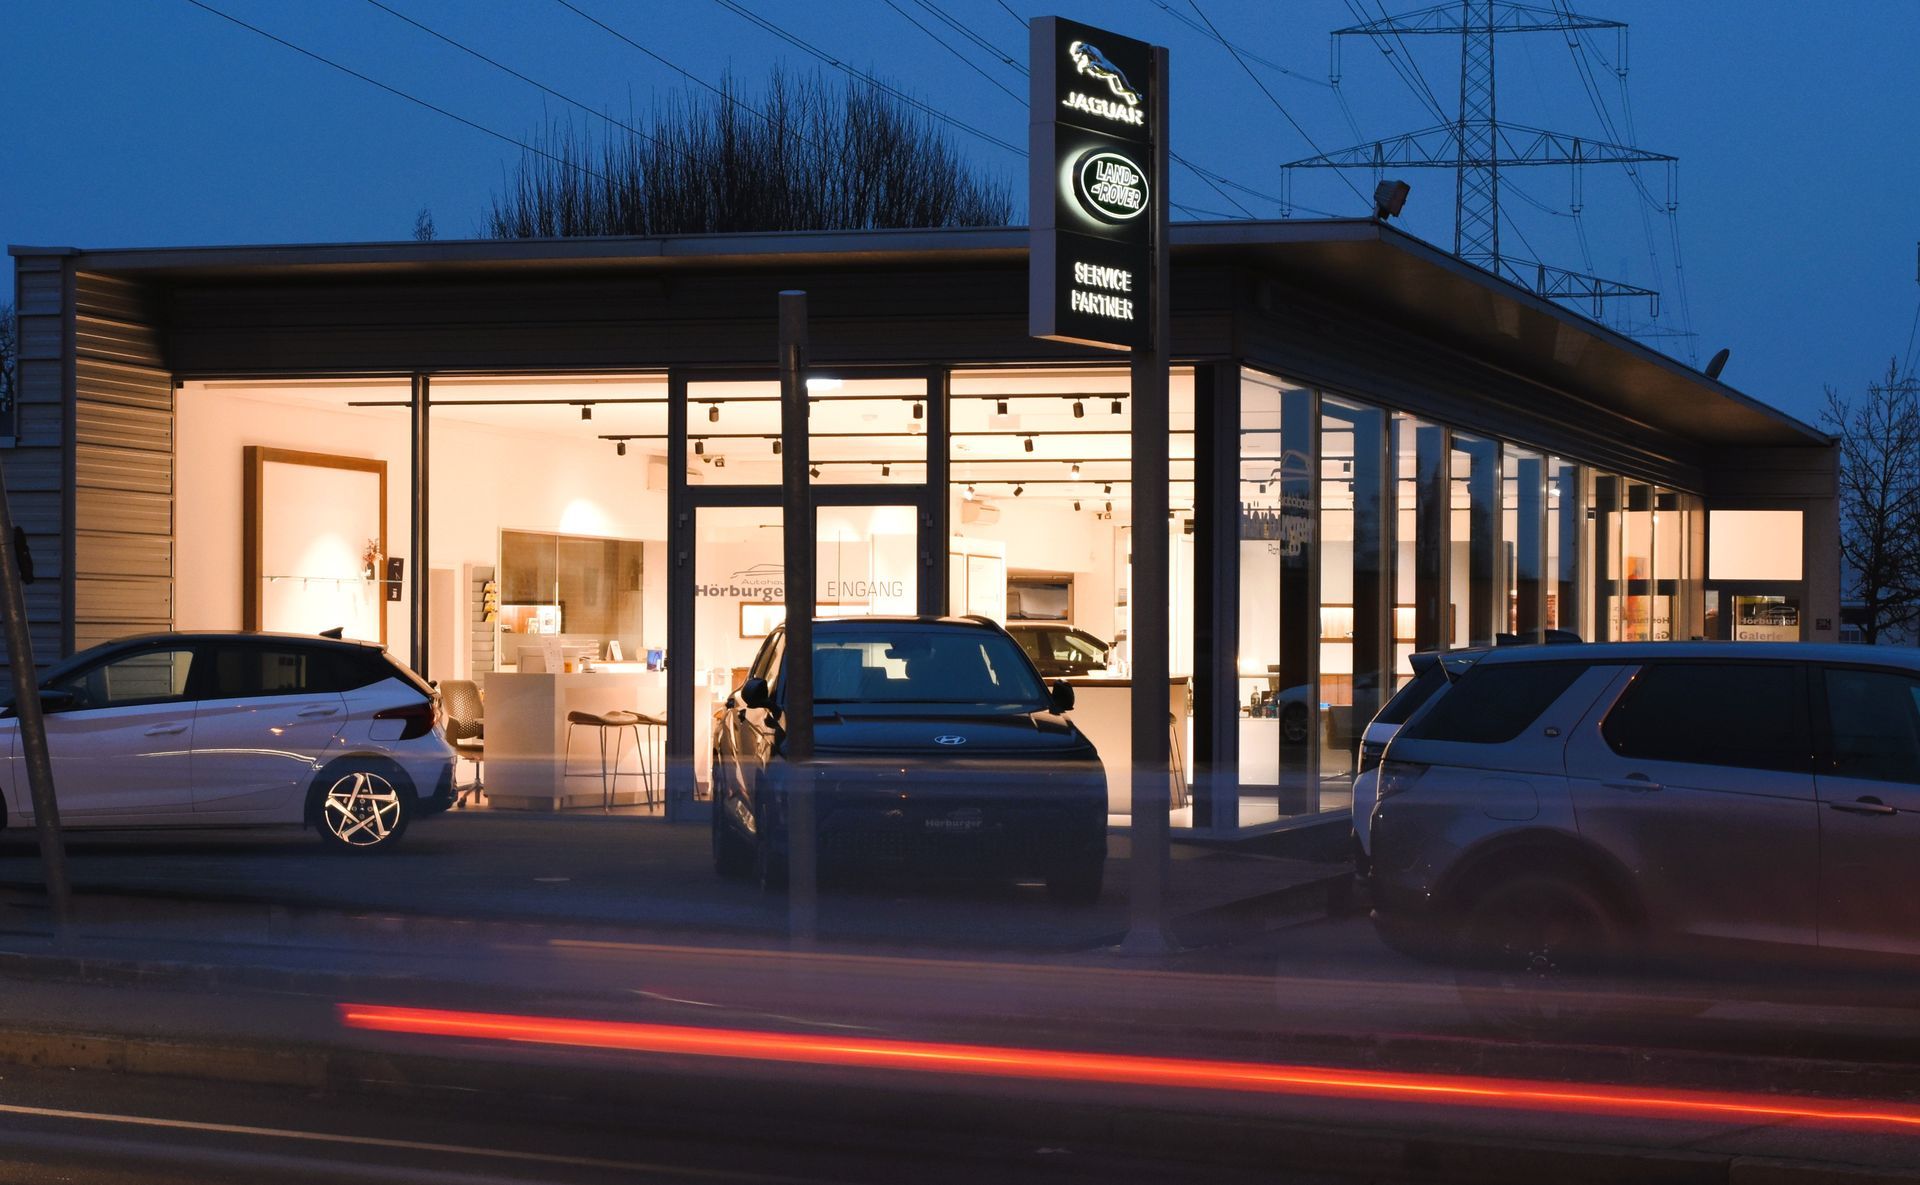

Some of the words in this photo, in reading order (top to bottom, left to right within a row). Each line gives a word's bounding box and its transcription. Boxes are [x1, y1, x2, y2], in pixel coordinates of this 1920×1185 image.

[1062, 91, 1144, 126] JAGUAR
[1098, 181, 1142, 209] ROVER
[1074, 261, 1132, 292] SERVICE
[1071, 289, 1134, 320] PARTNER
[695, 583, 784, 602] Hörburge
[741, 578, 784, 586] Autohau
[827, 580, 903, 597] EINGANG
[1739, 631, 1784, 640] Galerie
